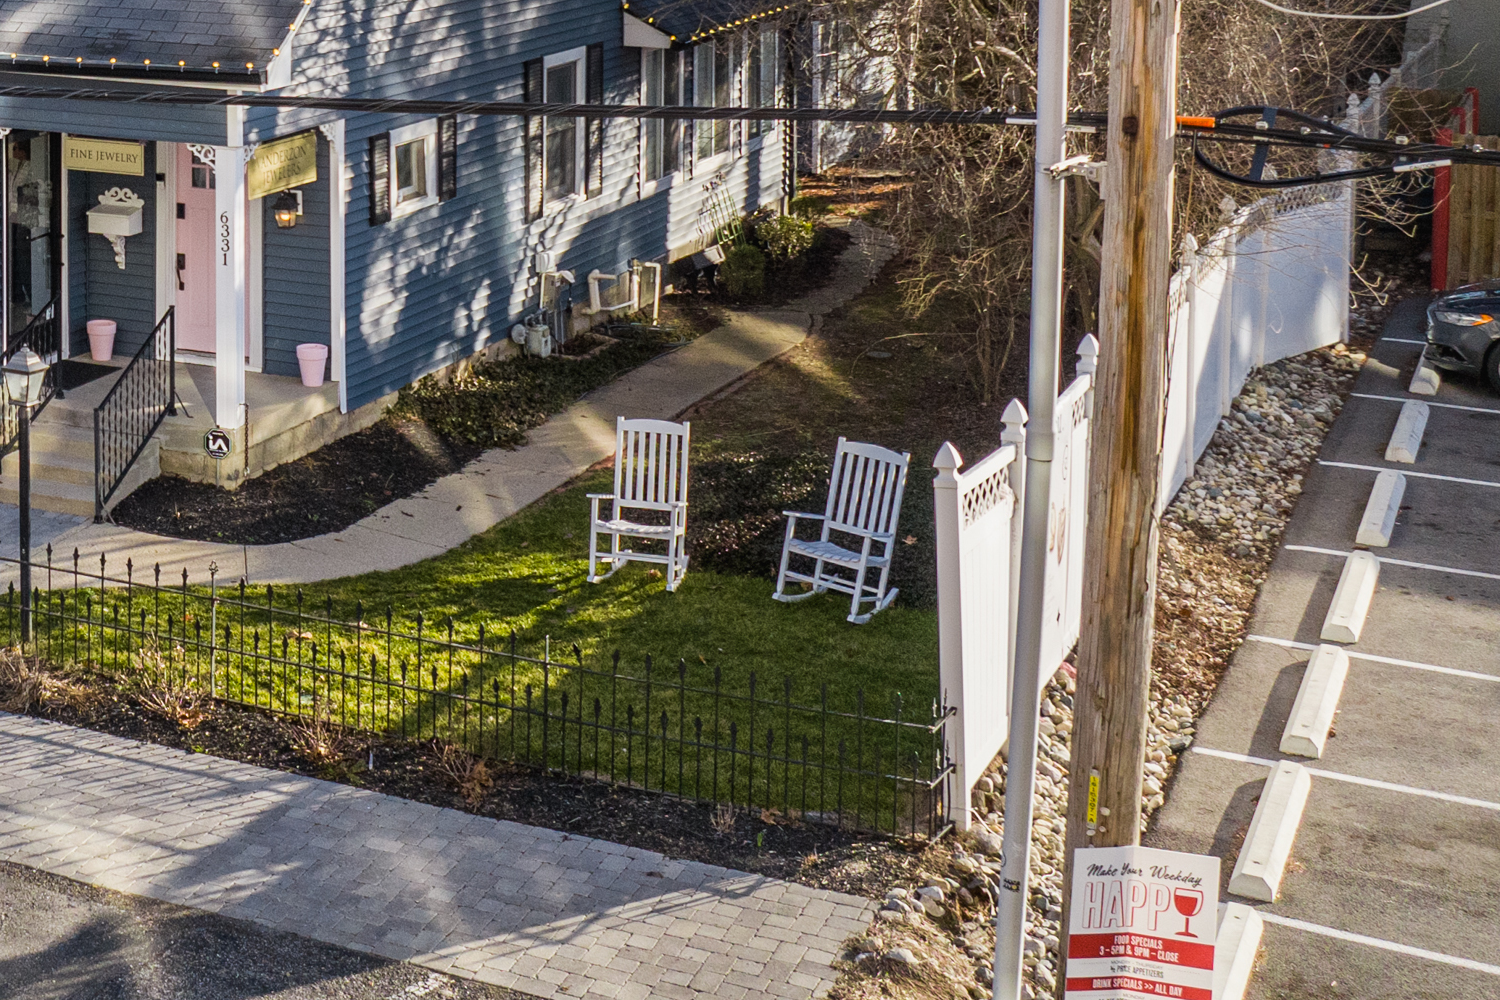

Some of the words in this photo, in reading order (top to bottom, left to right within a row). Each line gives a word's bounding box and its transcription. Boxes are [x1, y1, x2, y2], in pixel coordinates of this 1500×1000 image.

[70, 148, 93, 160] FINE
[96, 150, 139, 164] JEWELRY
[220, 210, 230, 267] 6331
[1087, 863, 1118, 877] Make
[1120, 862, 1143, 877] Your
[1150, 865, 1203, 888] Weekday
[1114, 935, 1130, 945] FOOD
[1130, 936, 1163, 950] SPECIALS
[1099, 946, 1105, 956] 3
[1111, 945, 1125, 955] 5PM
[1125, 945, 1132, 955] &
[1134, 946, 1150, 958] 9PM
[1157, 950, 1179, 963] CLOSE
[1132, 966, 1164, 979] APPETIZERS
[1092, 978, 1112, 989] DRINK
[1112, 978, 1143, 990] SPECIALS
[1154, 983, 1168, 995] ALL
[1168, 985, 1183, 997] DAY
